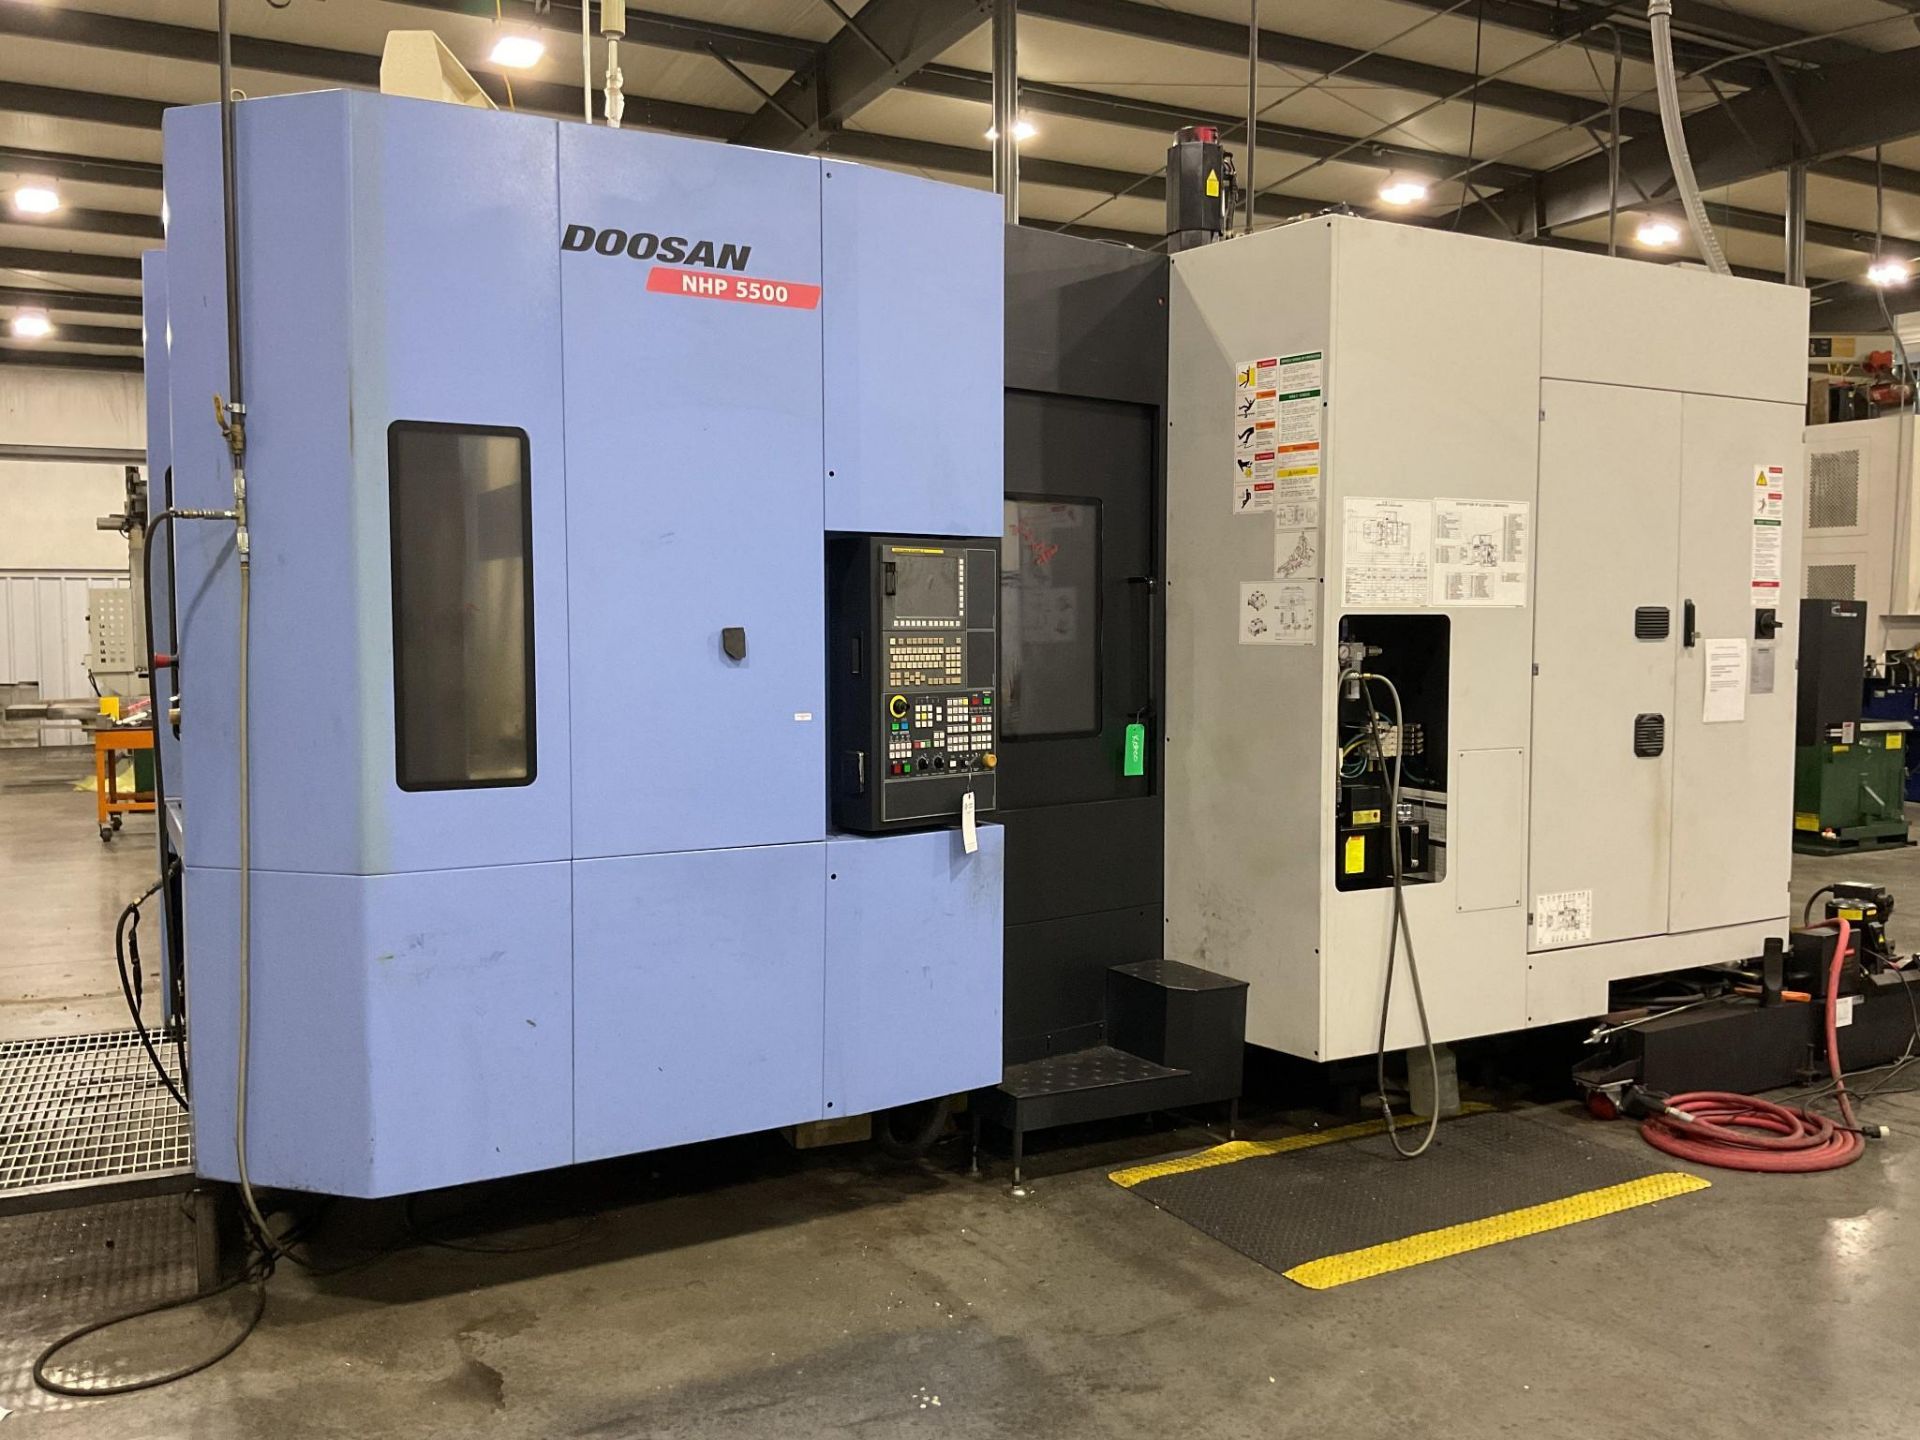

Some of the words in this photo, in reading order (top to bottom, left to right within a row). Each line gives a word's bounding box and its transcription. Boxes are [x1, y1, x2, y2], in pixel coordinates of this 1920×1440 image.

[561, 224, 751, 271] DOOSAN
[682, 274, 728, 295] NHP
[736, 282, 788, 302] 5500
